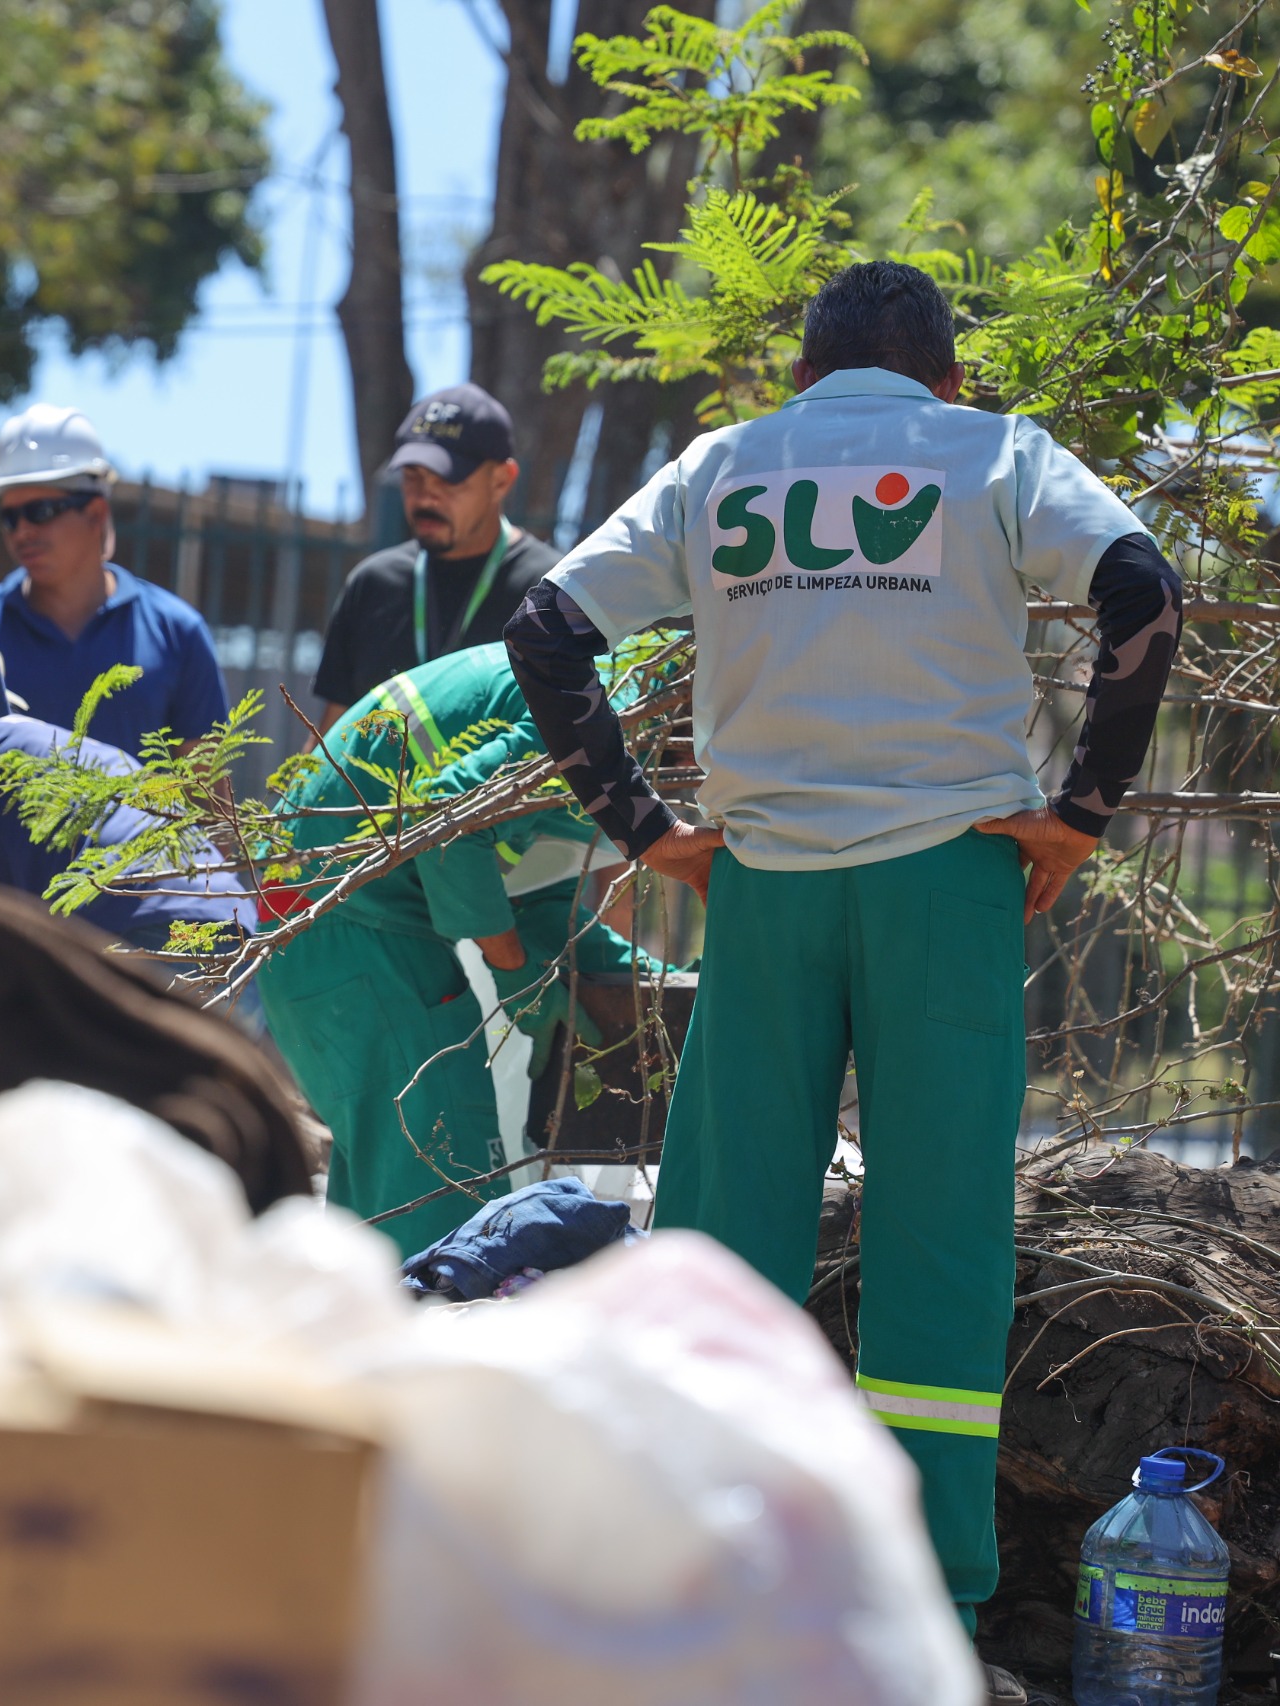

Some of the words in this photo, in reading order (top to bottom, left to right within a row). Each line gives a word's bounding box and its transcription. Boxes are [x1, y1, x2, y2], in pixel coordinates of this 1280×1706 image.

[425, 402, 460, 423] DF
[726, 578, 773, 602] SERVIÇO
[775, 575, 793, 590] DE
[797, 575, 863, 591] LIMPEZA
[866, 575, 932, 593] URBANA
[1138, 1594, 1167, 1606] beba
[1137, 1615, 1165, 1624] mineral
[1136, 1622, 1165, 1631] natural
